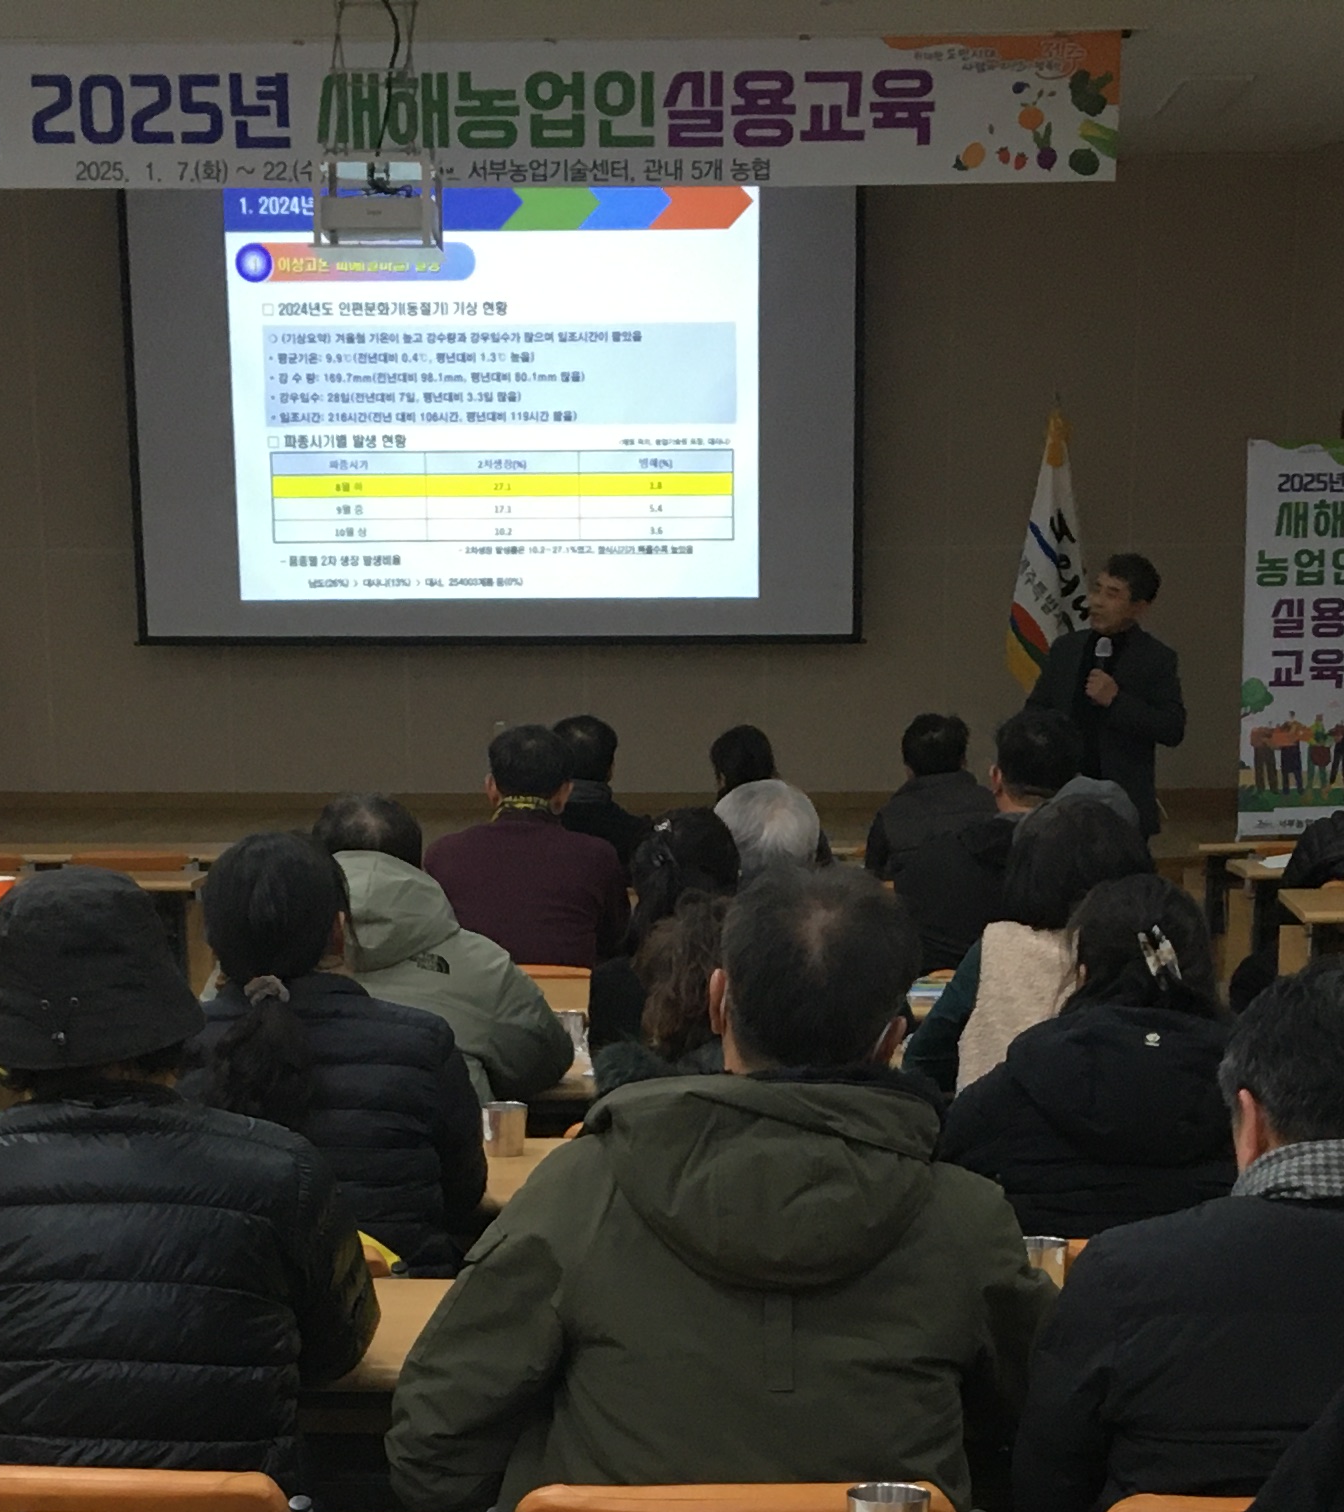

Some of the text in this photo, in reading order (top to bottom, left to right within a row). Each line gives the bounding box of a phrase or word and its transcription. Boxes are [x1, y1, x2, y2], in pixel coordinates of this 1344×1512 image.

[30, 72, 291, 149] 2025년
[76, 161, 129, 183] 2025.
[146, 162, 161, 183] 1.
[177, 160, 229, 184] 7.(화)
[467, 157, 635, 184] 서부농업기술센터,
[642, 156, 685, 184] 관내
[691, 157, 723, 182] 5개
[730, 155, 772, 183] 농협
[239, 197, 253, 214] 1.
[278, 302, 334, 316] 2024년도
[453, 301, 477, 316] 기상
[483, 301, 508, 316] 현황
[284, 434, 407, 449] 파종시기별 발생 현황
